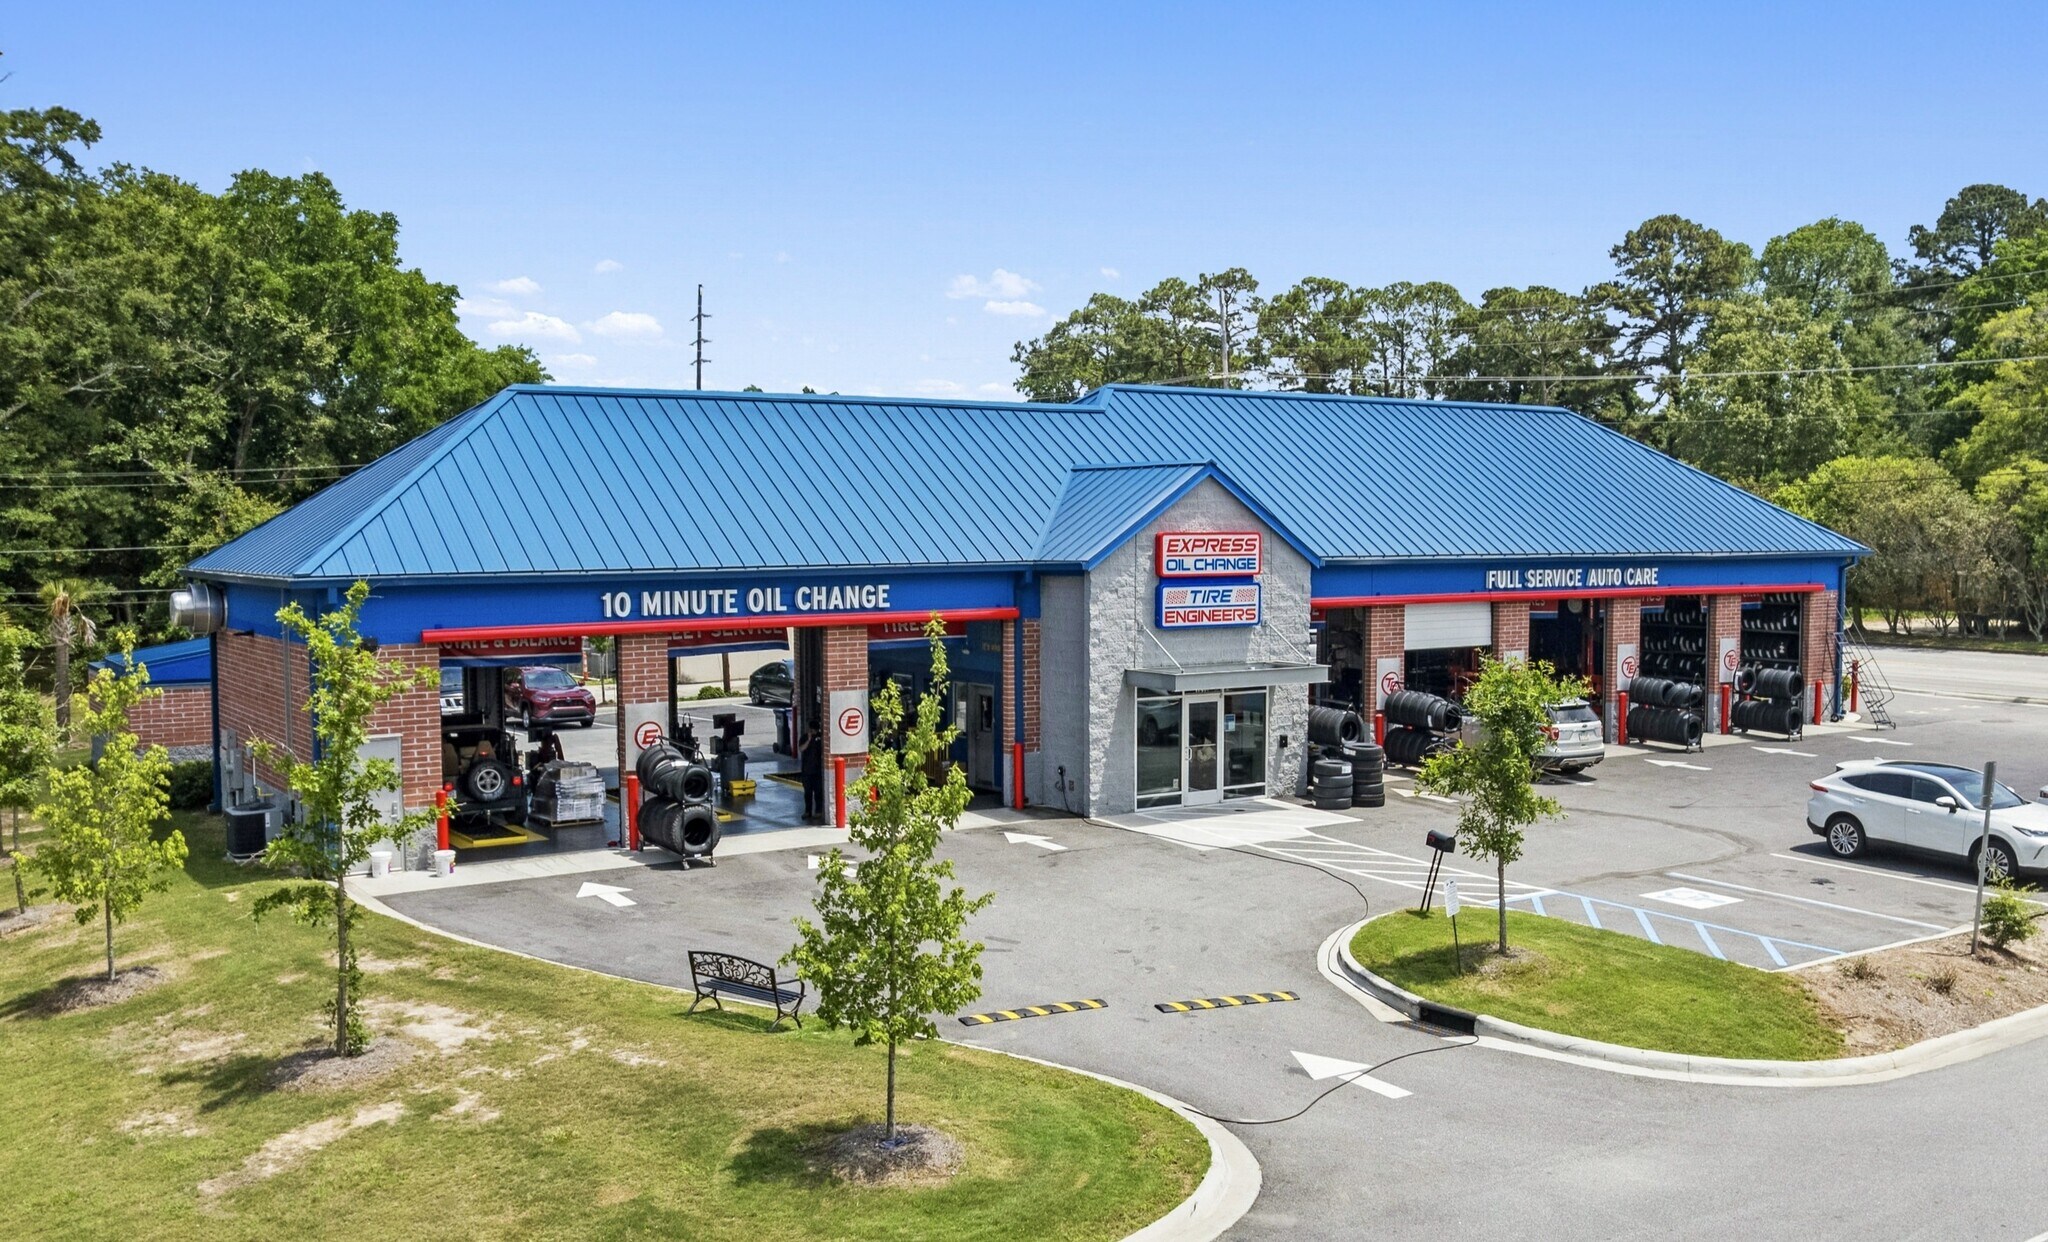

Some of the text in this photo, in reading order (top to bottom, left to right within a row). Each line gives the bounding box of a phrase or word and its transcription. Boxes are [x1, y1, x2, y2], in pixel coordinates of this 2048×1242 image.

[1166, 538, 1258, 553] EXPRESS
[1166, 557, 1257, 571] OIL CHANGE
[1487, 568, 1659, 589] FULL SERVICE AUTO CARE
[601, 585, 891, 618] 10 MINUTE OIL CHANGE
[1190, 589, 1233, 604] TIRE
[1164, 608, 1257, 624] ENGINEERS
